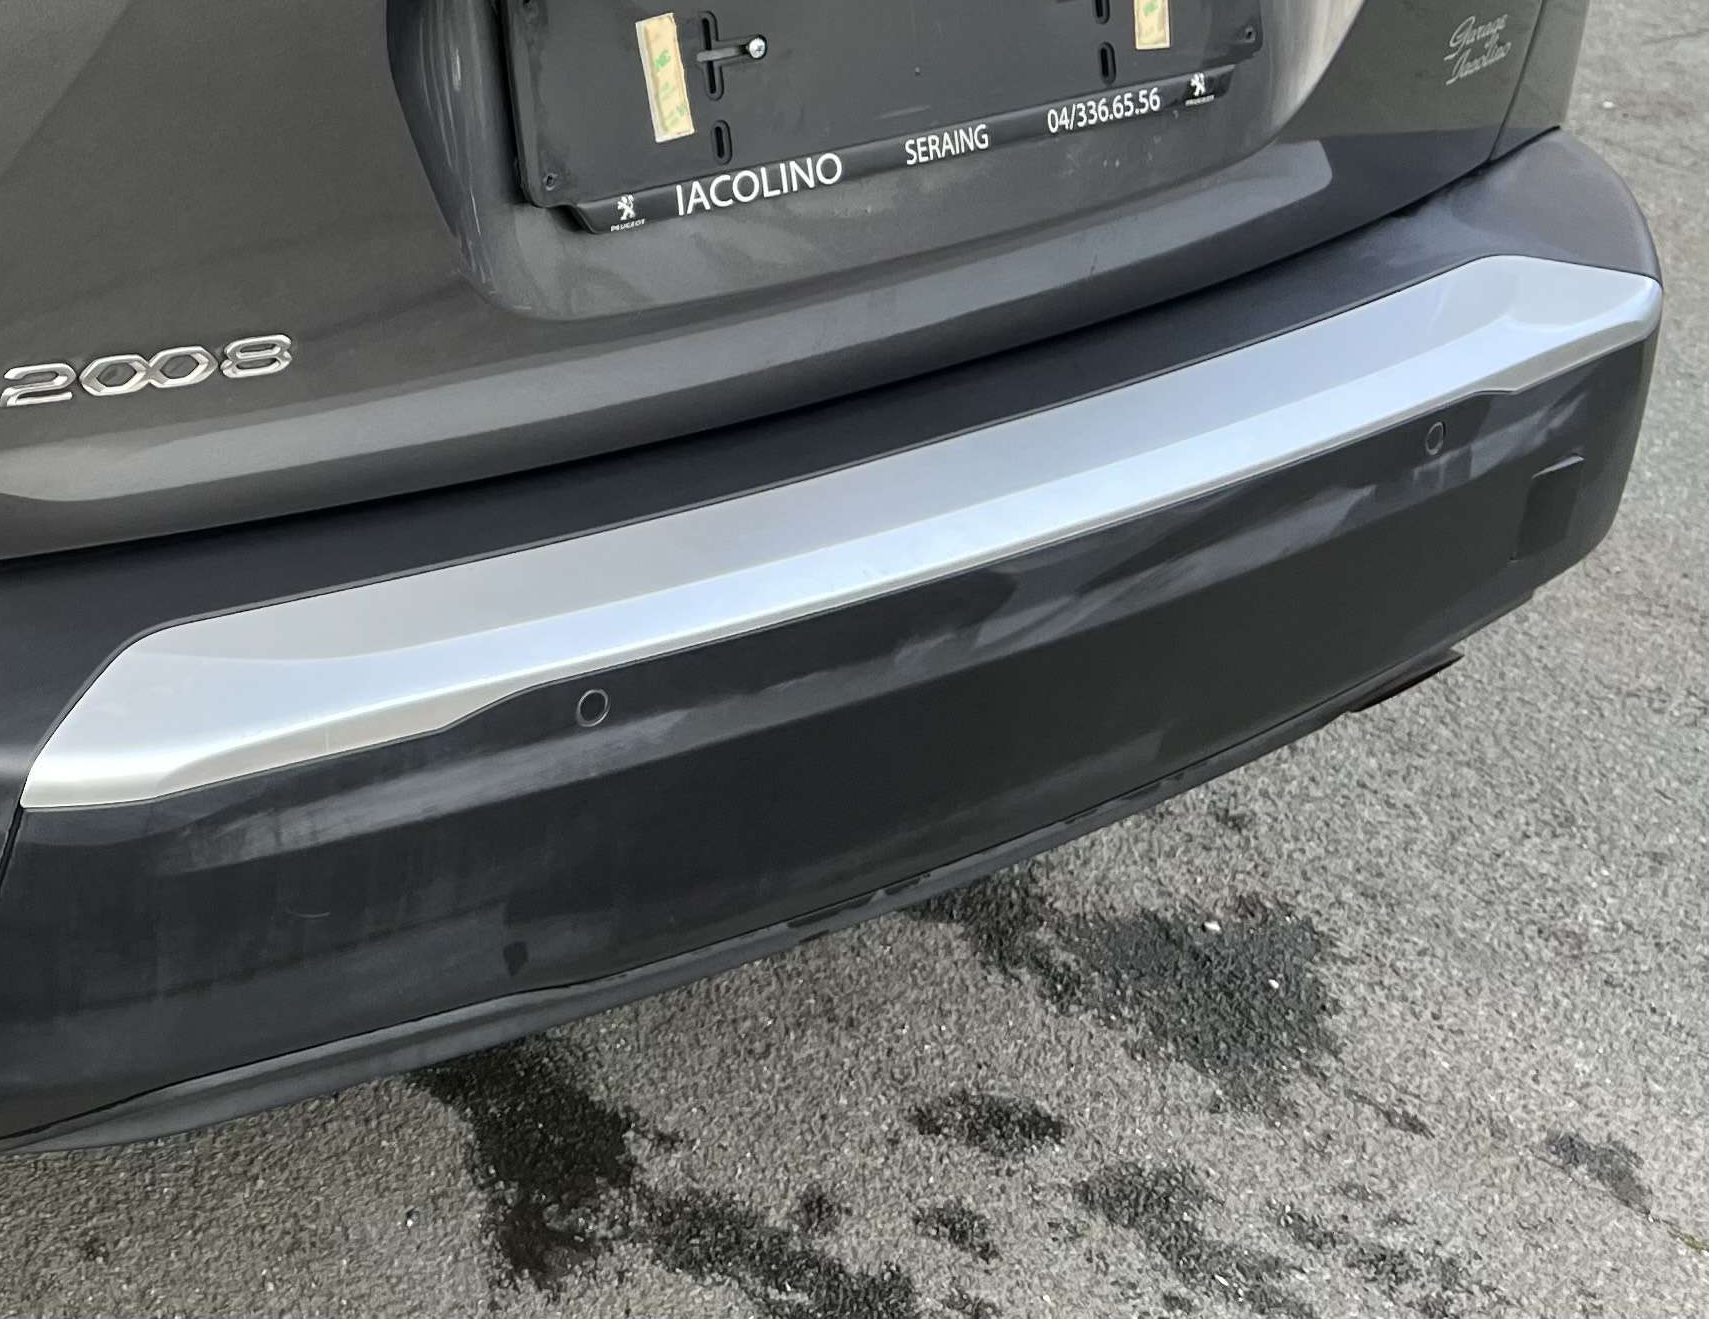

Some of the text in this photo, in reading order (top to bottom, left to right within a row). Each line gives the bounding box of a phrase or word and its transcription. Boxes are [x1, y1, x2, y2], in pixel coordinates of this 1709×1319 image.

[675, 87, 1162, 216] IACOLINO SERAING 04/336.65.56
